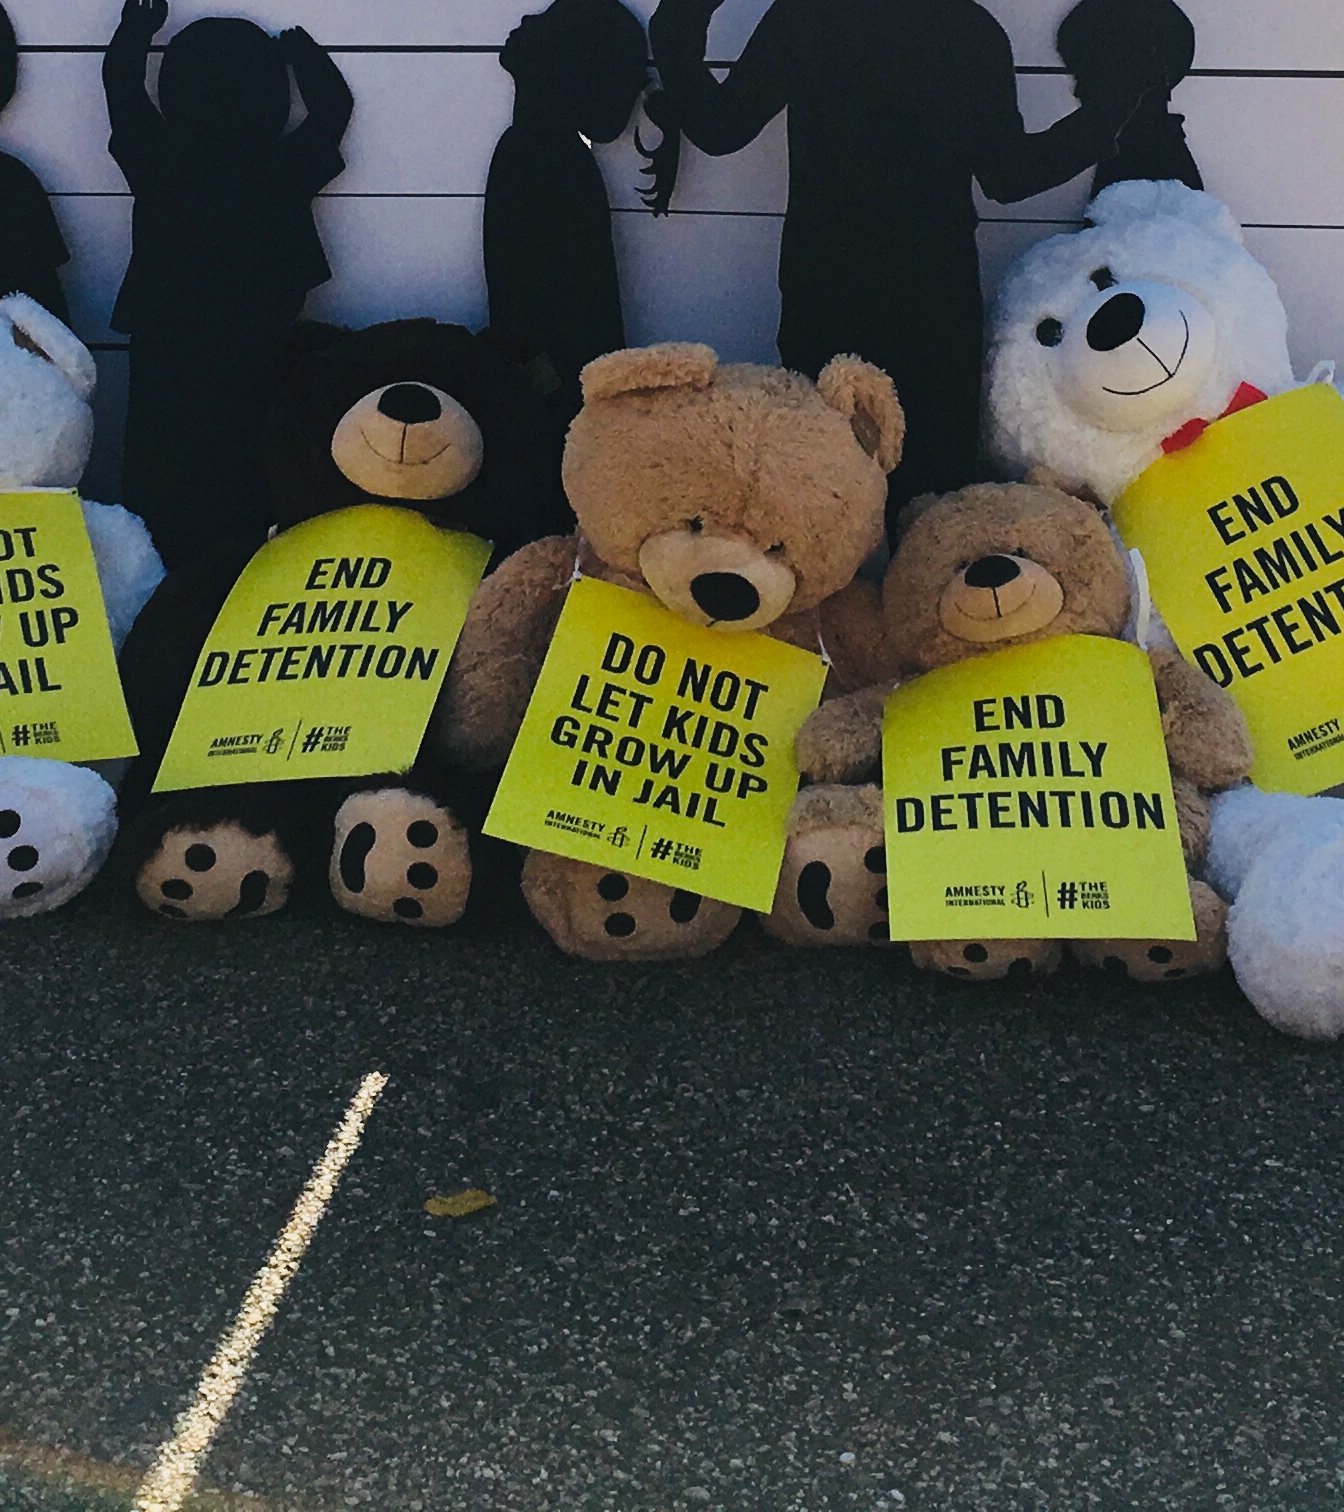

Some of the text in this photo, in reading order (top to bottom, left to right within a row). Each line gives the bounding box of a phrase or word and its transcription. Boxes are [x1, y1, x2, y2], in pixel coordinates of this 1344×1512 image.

[1207, 475, 1299, 546] END
[305, 557, 392, 590] END
[19, 606, 79, 648] UP
[257, 600, 414, 637] FAMILY
[197, 644, 439, 688] DETENTION
[601, 632, 769, 720] DO NOT
[571, 674, 769, 768] LET KIDS
[973, 694, 1066, 732] END
[210, 734, 264, 748] AMNESTY
[1287, 718, 1341, 751] AMNESTY
[550, 715, 768, 799] GROW UP
[941, 741, 1108, 781] FAMILY
[571, 759, 726, 828] IN JAIL
[896, 790, 1165, 833] DETENTION
[546, 810, 606, 832] AMNESTY
[945, 885, 1006, 898] AMNESTY
[1079, 881, 1107, 892] THE
[1082, 899, 1110, 910] KIDS
